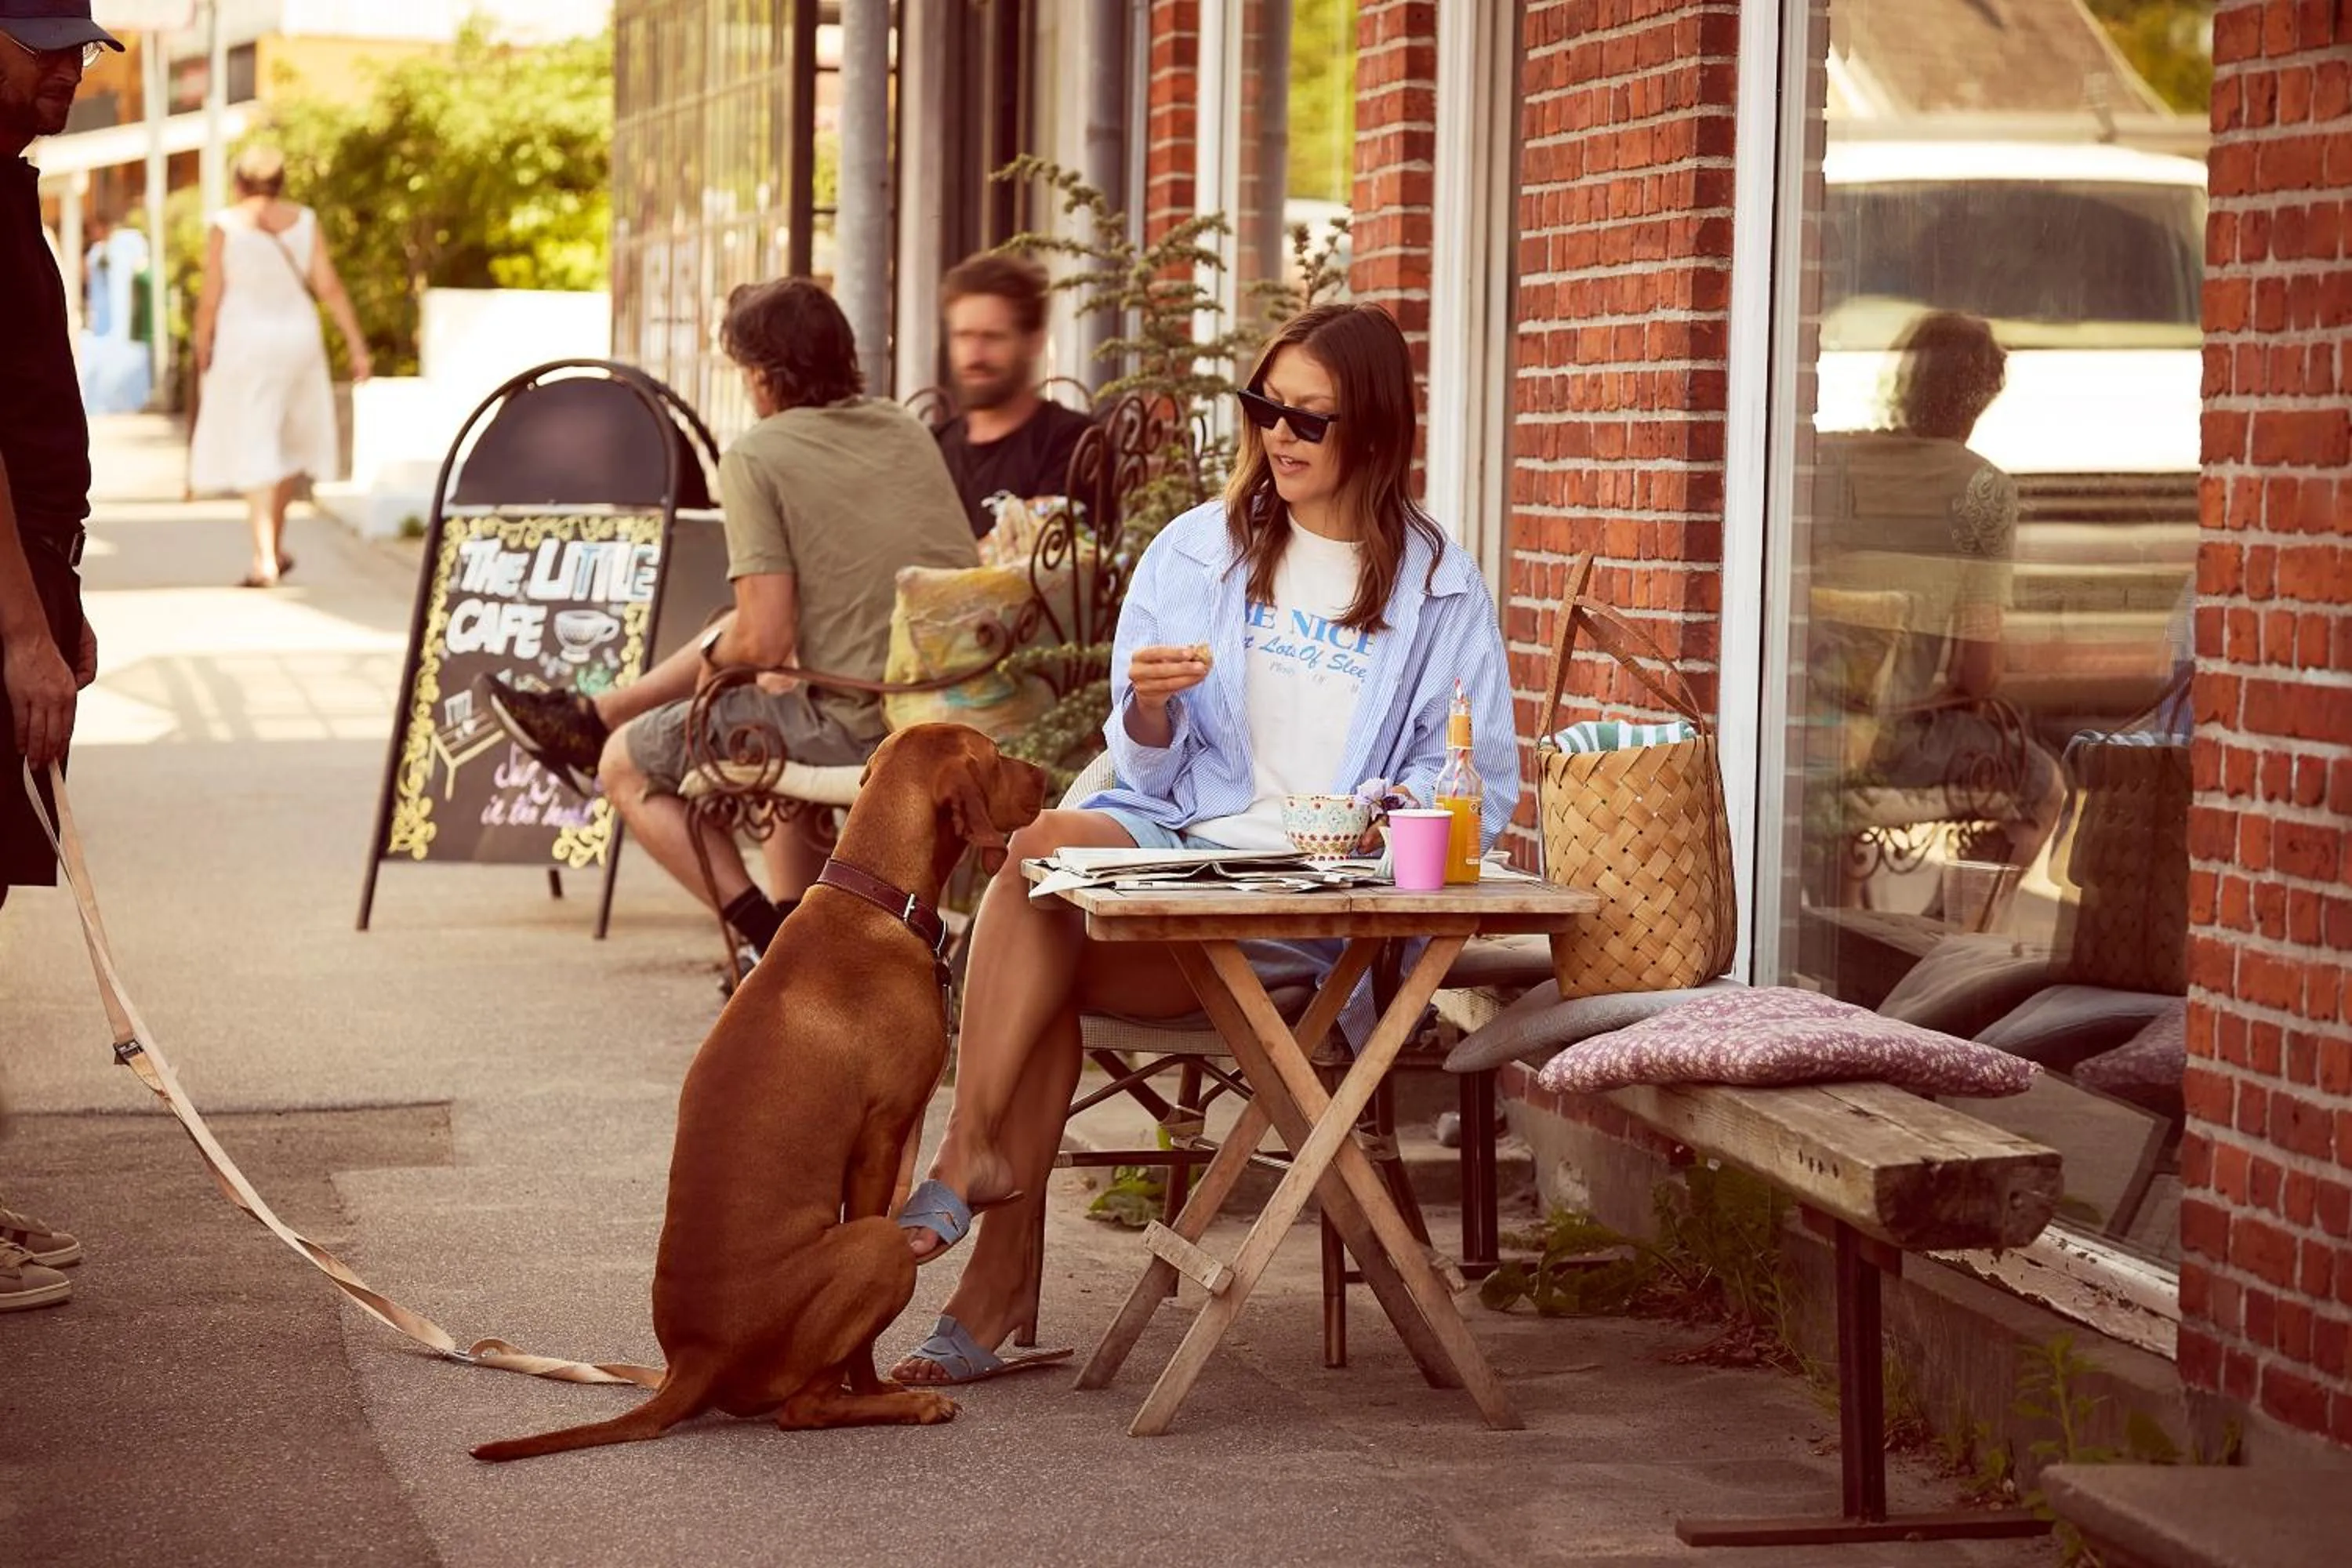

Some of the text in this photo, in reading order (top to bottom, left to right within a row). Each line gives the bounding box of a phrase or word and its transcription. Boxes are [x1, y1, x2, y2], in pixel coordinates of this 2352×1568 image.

[459, 538, 662, 602] THE LITTLE
[446, 598, 547, 659] CAFE
[1245, 601, 1278, 629] E
[1299, 645, 1324, 670] Of
[1327, 653, 1369, 683] Slee
